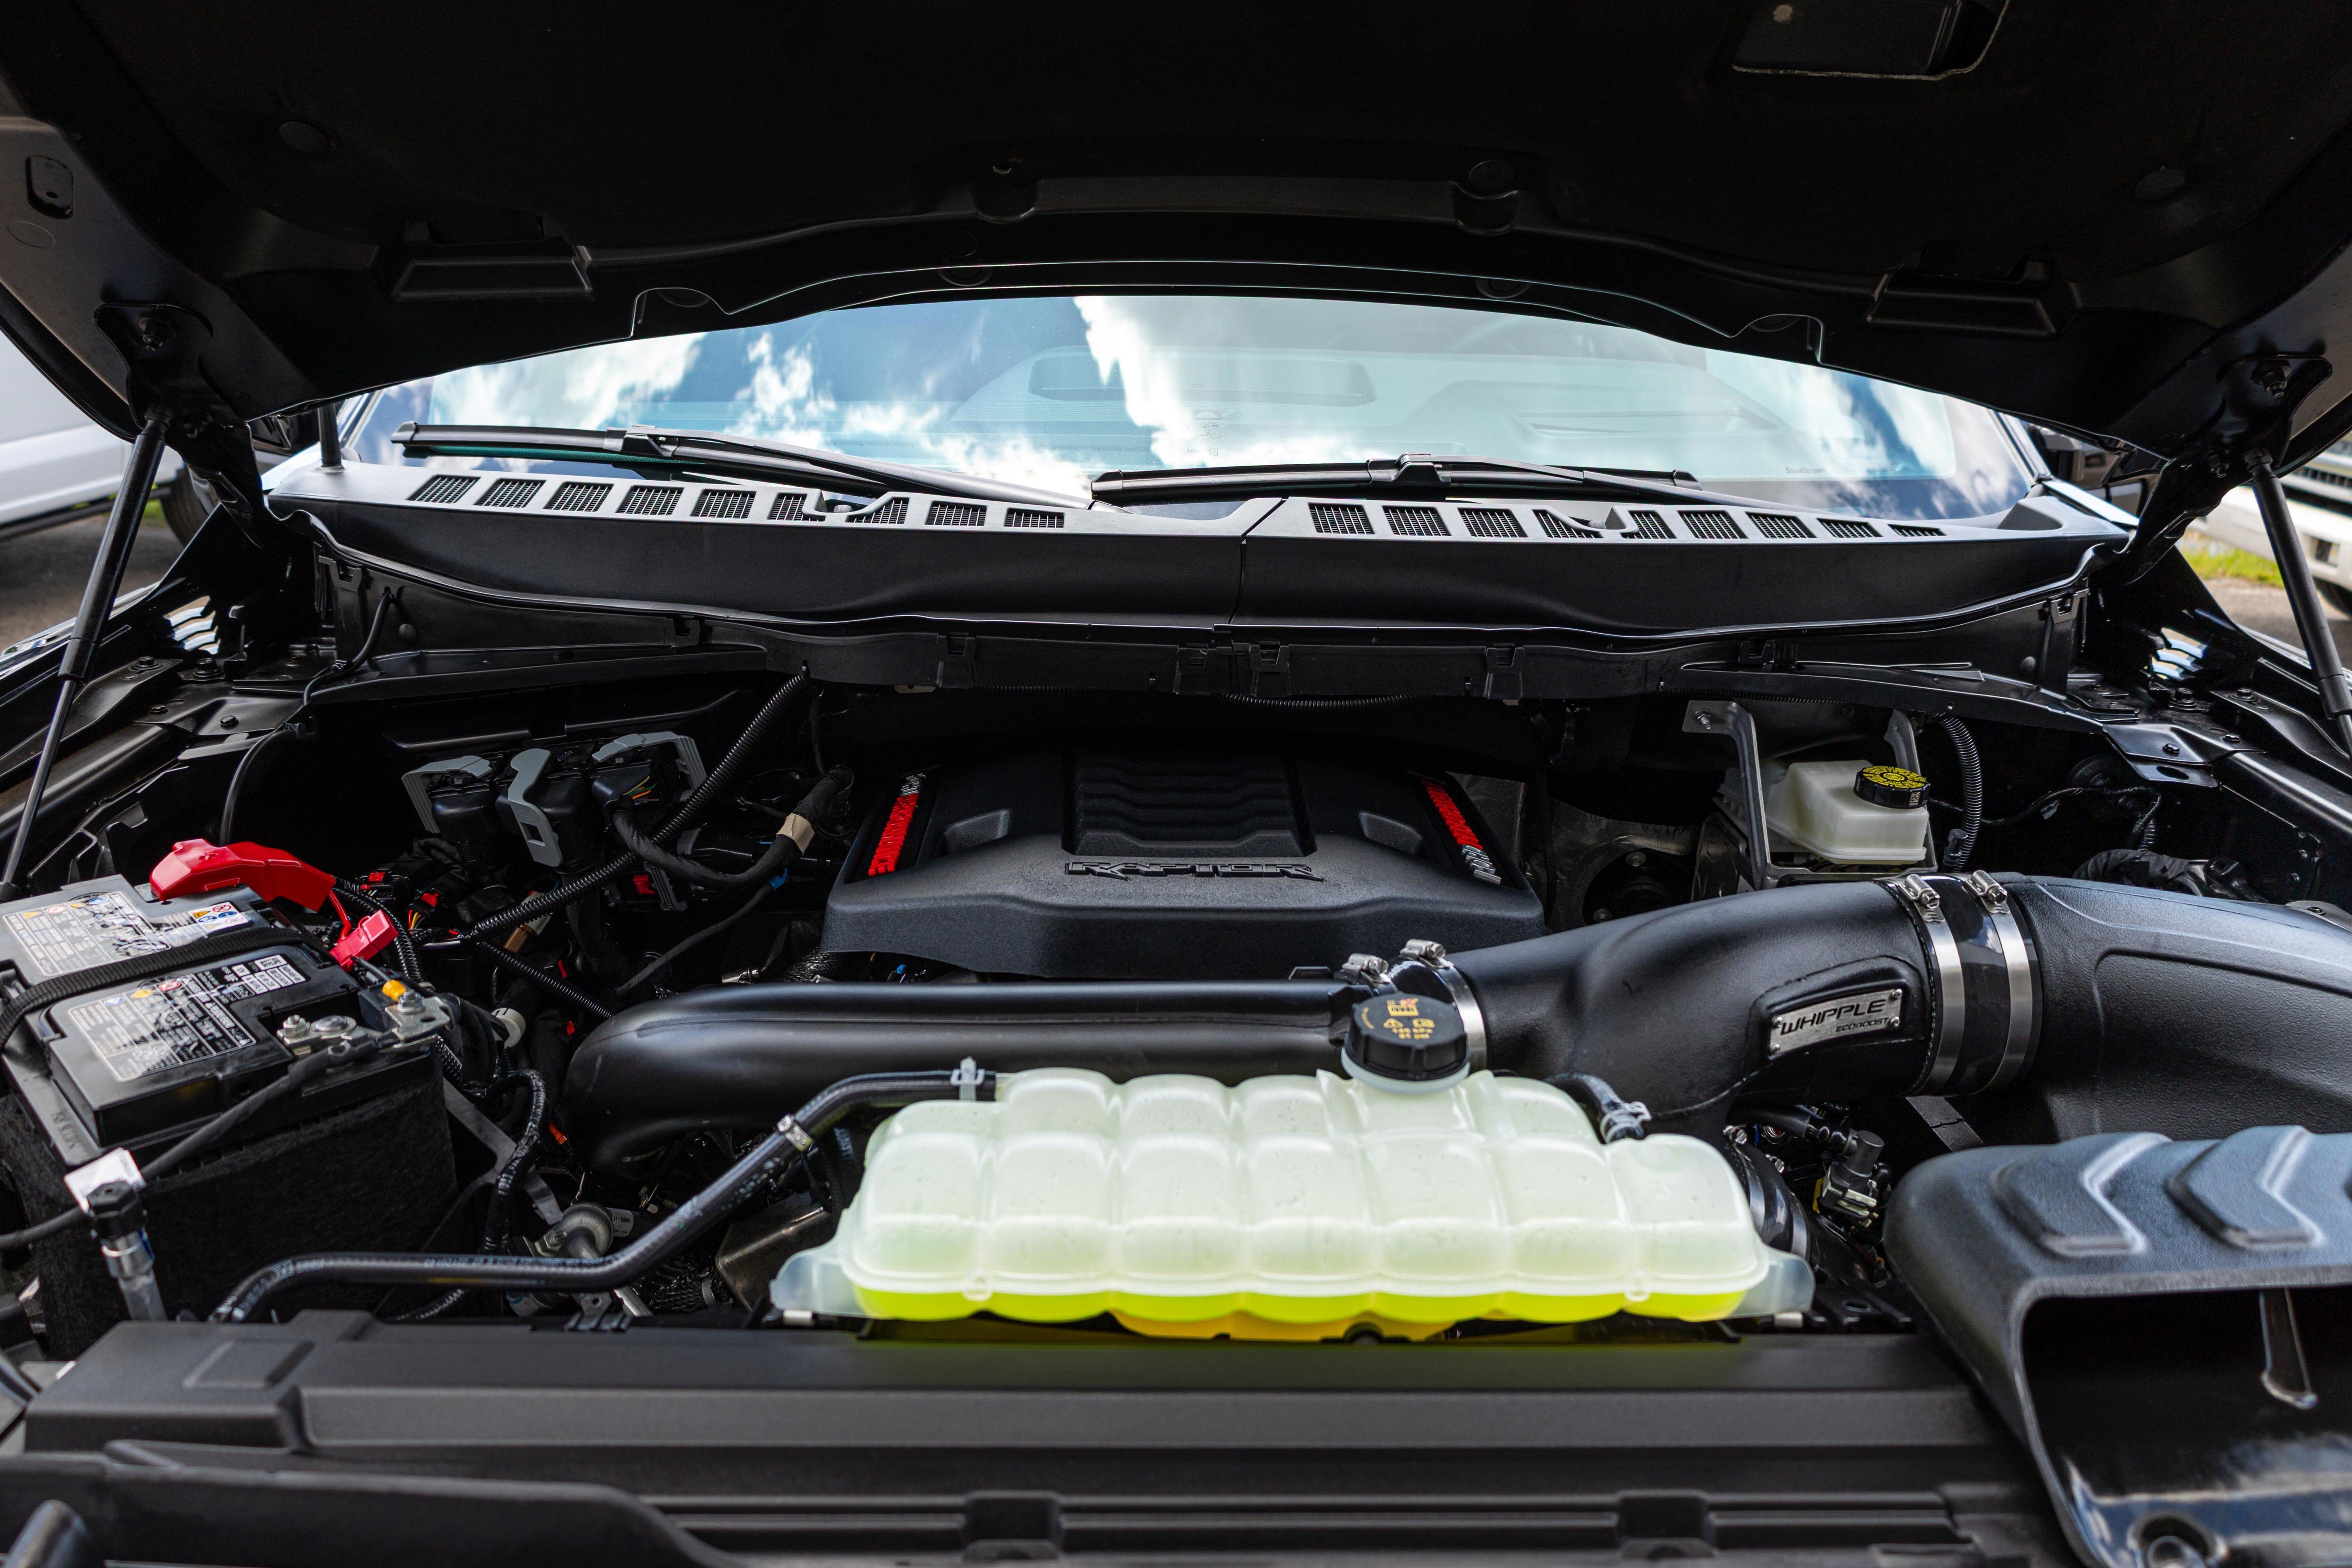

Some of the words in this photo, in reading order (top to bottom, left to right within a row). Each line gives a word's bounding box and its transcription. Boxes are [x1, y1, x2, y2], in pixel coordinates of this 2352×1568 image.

[1065, 861, 1326, 882] RAPTOR
[1780, 999, 1886, 1035] WHIPPLE
[1835, 1016, 1889, 1033] ECOBOOST
